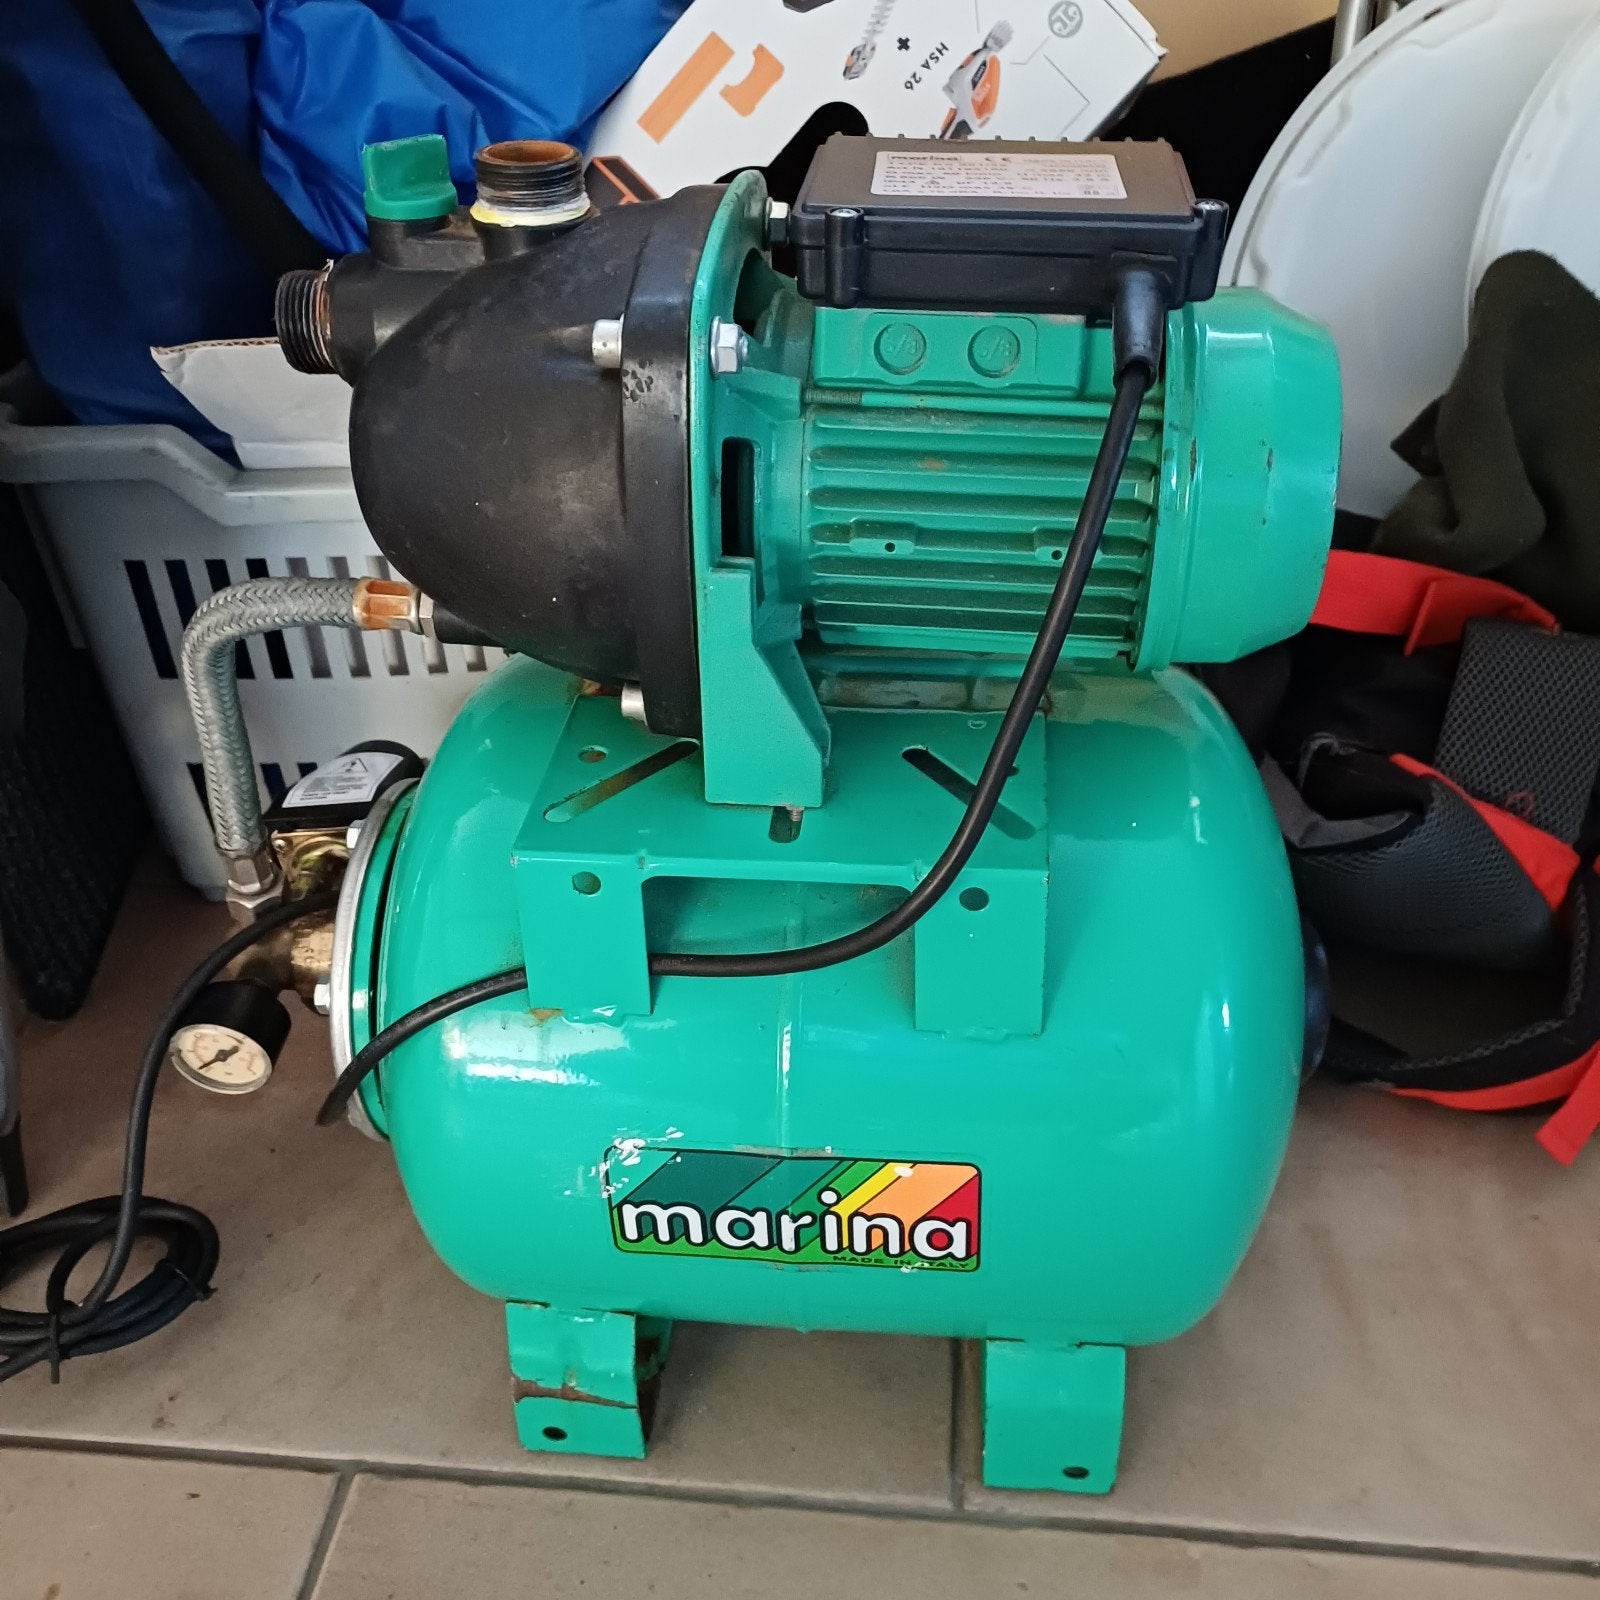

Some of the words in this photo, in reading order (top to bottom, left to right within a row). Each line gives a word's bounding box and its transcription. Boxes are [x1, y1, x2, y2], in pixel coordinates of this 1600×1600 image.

[920, 41, 950, 71] HSA
[904, 71, 922, 91] 26
[620, 1189, 968, 1258] marina
[832, 1255, 884, 1264] MADE
